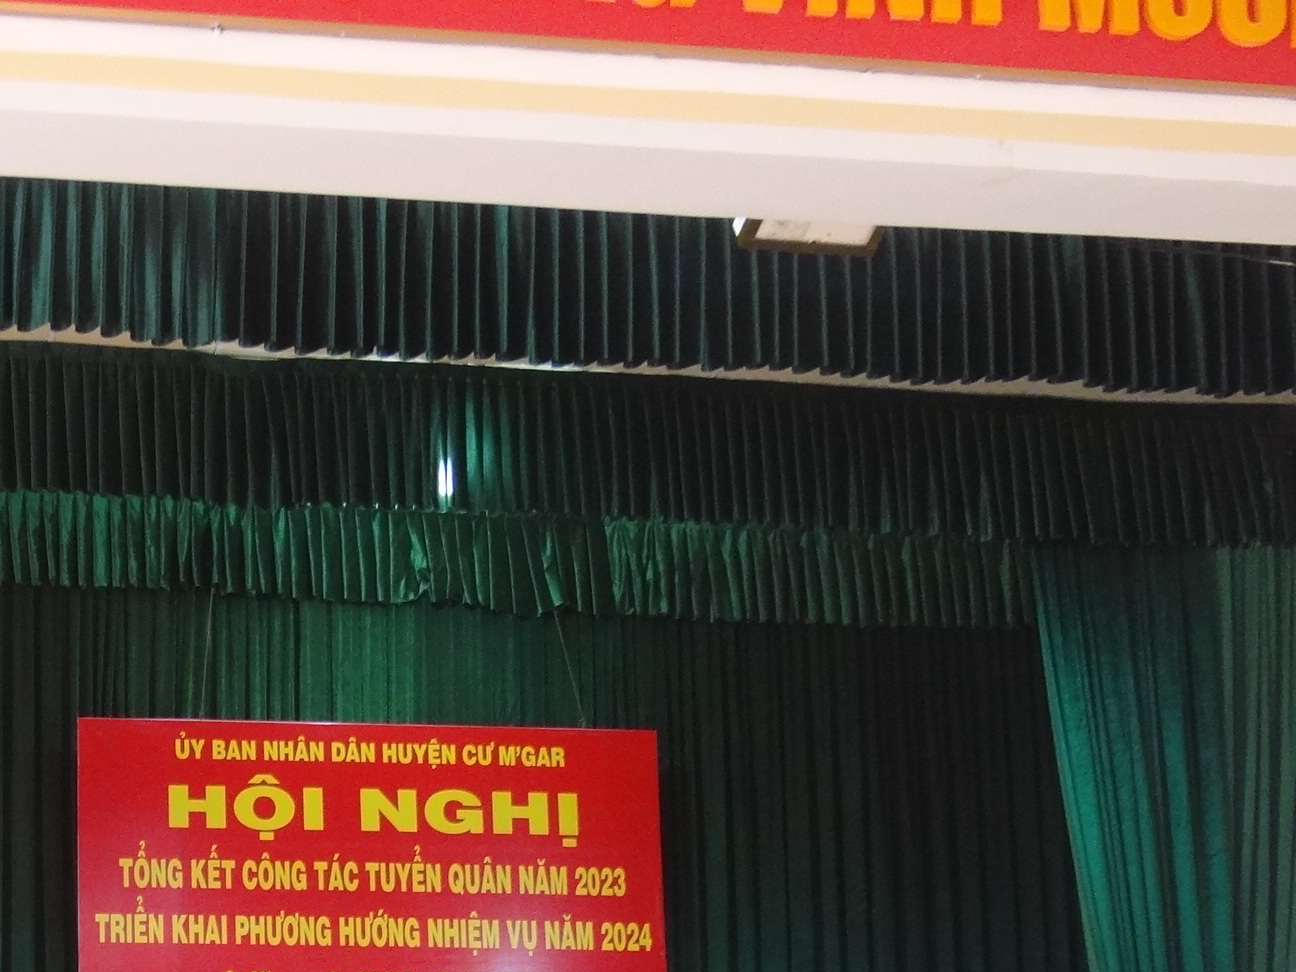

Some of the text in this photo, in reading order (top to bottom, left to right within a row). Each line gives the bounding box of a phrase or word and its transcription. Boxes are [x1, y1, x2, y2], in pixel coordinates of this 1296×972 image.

[175, 731, 204, 760] ỦY
[212, 739, 257, 761] BAN
[263, 736, 325, 762] NHÂN
[331, 737, 376, 763] DÂN
[382, 738, 456, 769] HUYỆN
[462, 741, 496, 766] CƯ
[168, 774, 579, 847] HỘI NGHỊ
[119, 840, 626, 897] TỔNG KẾT CÔNG TÁC TUYỂN QUÂN NĂM 2023
[95, 895, 652, 956] TRIỂN KHAI PHƯƠNG HƯỚNG NHIỆM VỤ NĂM 2024
